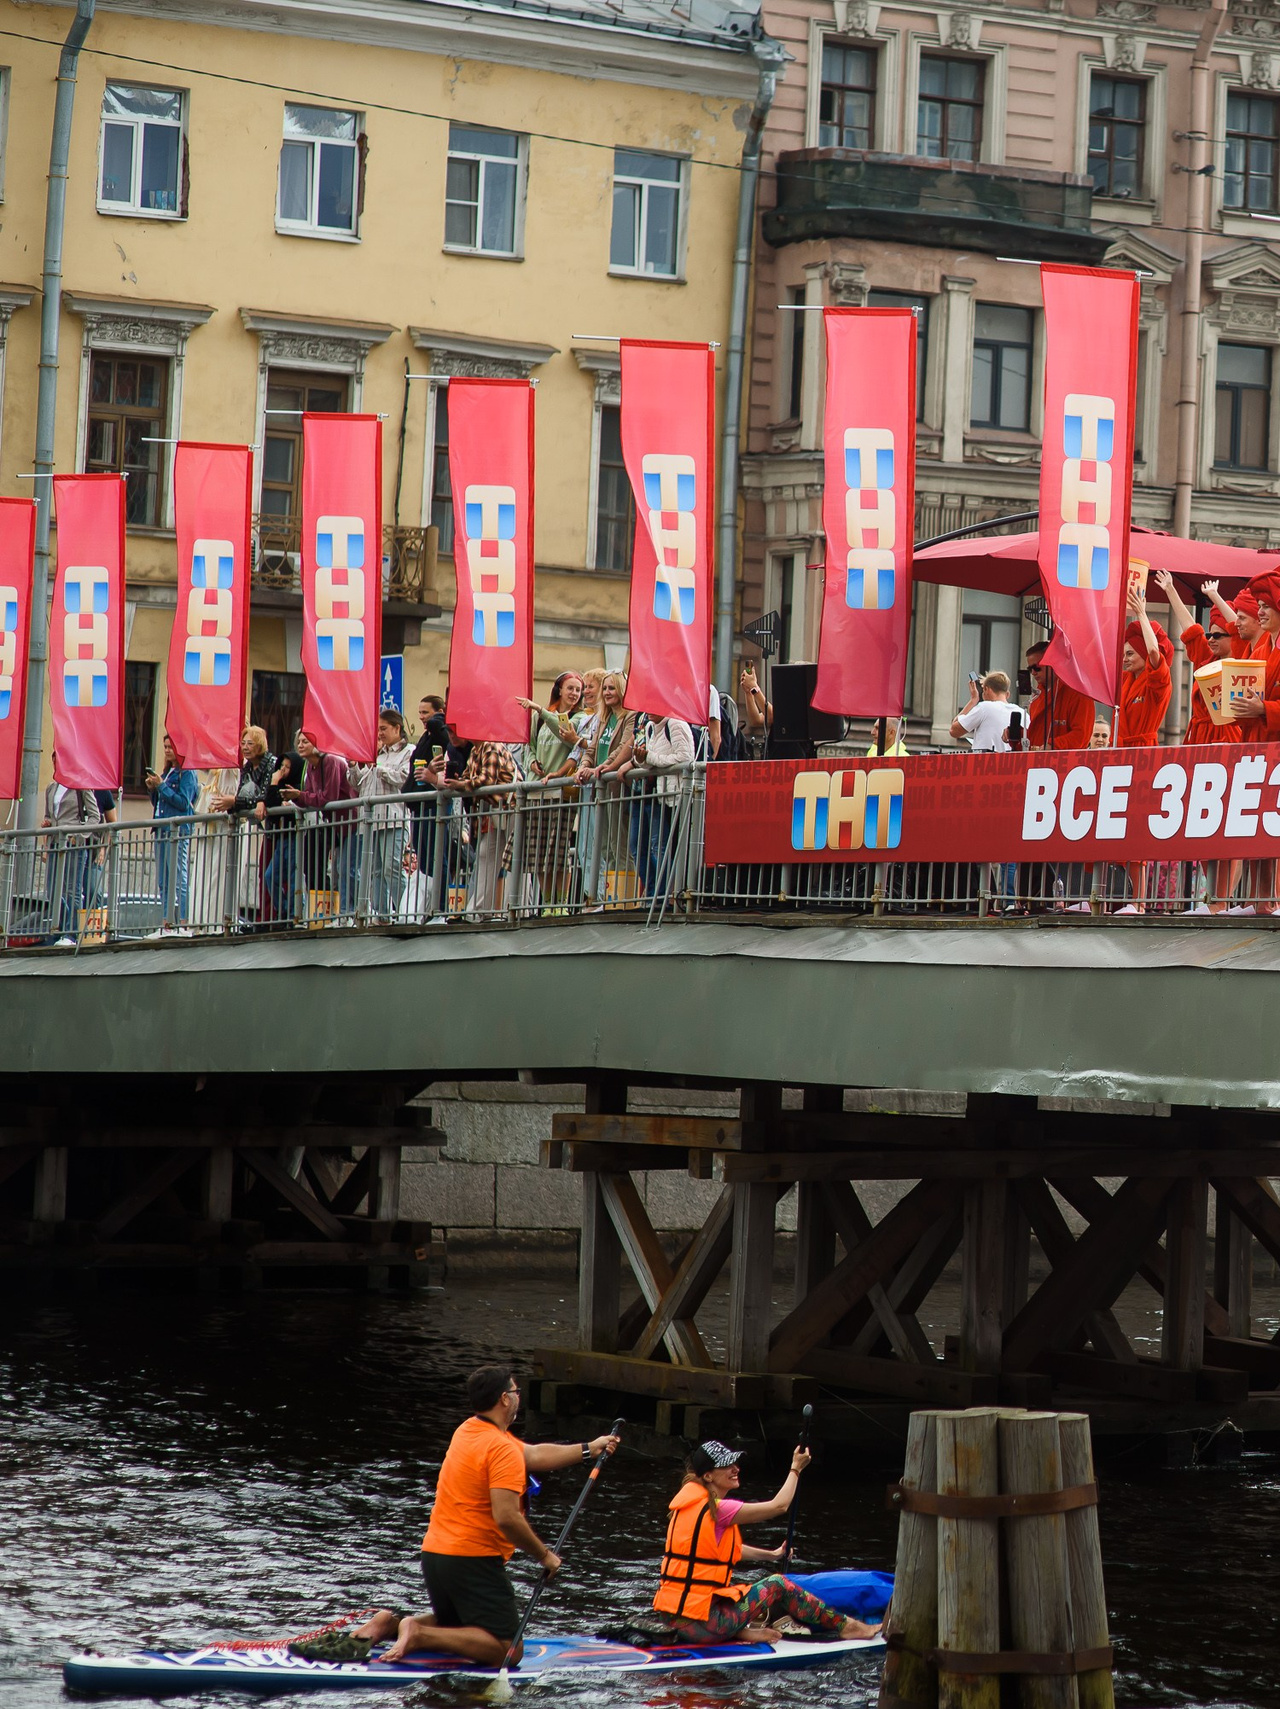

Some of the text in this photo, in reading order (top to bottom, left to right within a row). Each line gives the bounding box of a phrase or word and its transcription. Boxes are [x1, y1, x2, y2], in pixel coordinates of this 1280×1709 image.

[465, 485, 517, 648] ТНТ
[642, 453, 697, 626] ТНТ
[844, 427, 896, 610] ТНТ
[1057, 393, 1115, 591] ТНТ
[63, 565, 110, 708] ТНТ
[182, 538, 235, 687] ТНТ
[315, 515, 365, 672] ТНТ
[791, 768, 904, 850] ТНТ
[1022, 765, 1134, 841] ВСЕ
